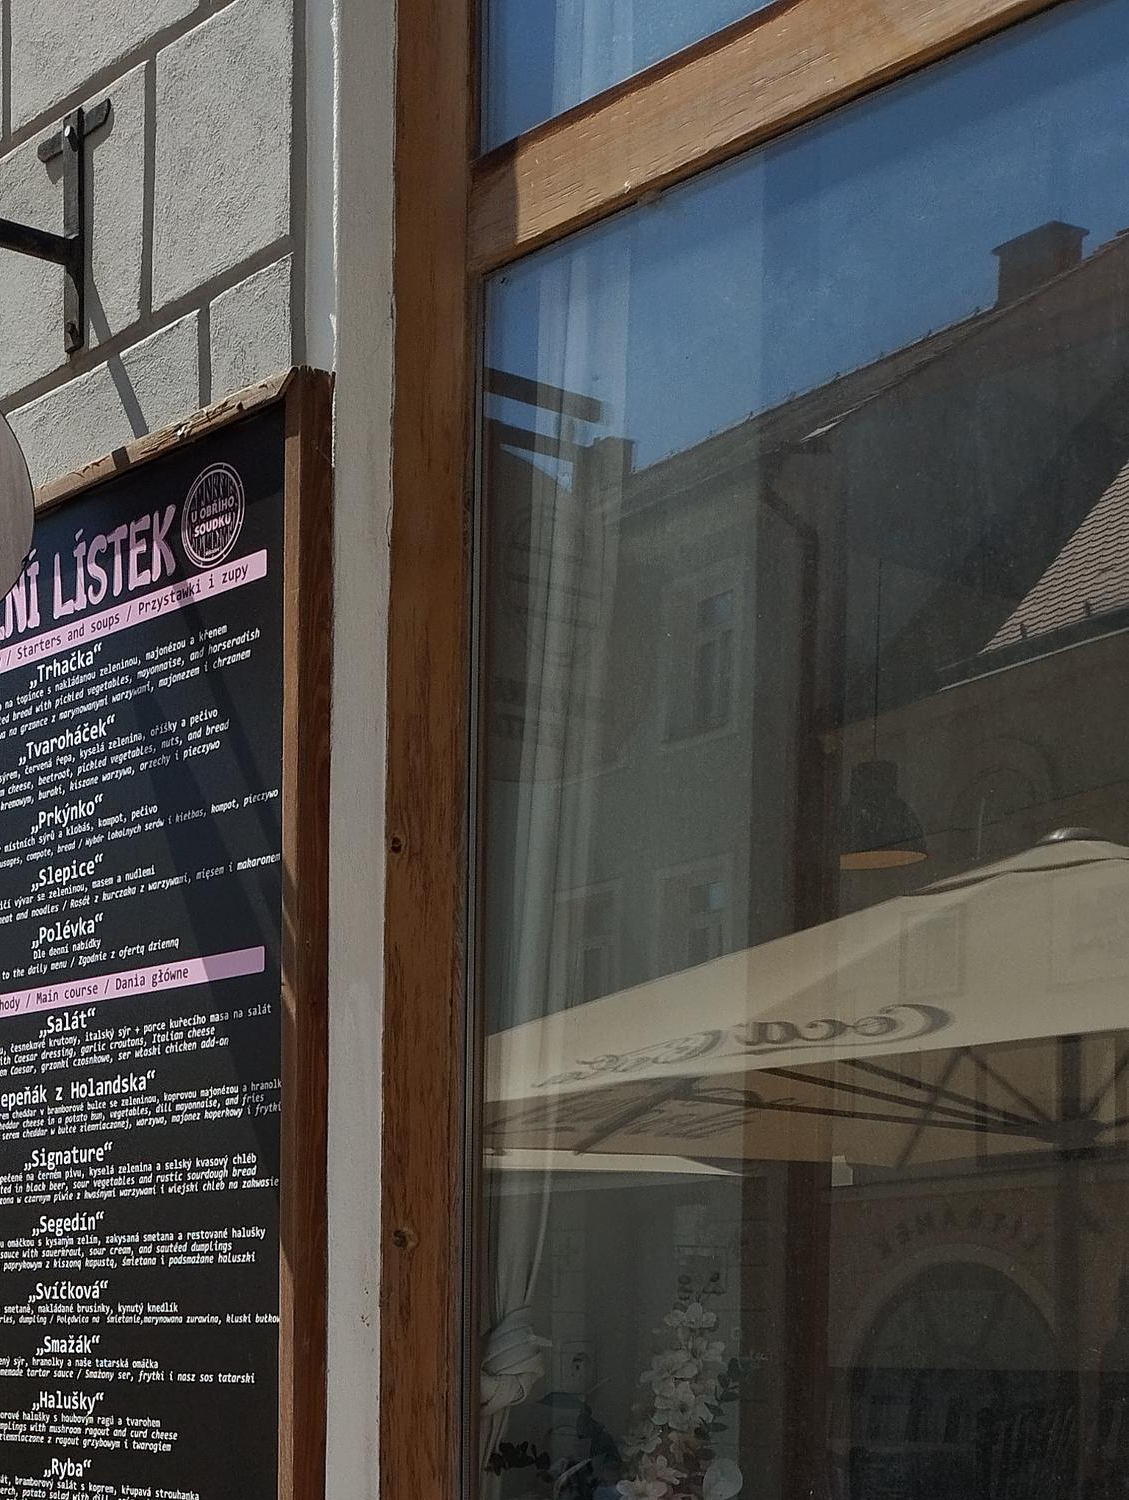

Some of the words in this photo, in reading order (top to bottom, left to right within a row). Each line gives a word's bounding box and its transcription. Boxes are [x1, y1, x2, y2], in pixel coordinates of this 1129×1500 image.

[194, 511, 232, 538] SOUDKU
[52, 504, 177, 620] LÍSTEK
[16, 635, 60, 660] Starters
[66, 624, 83, 642] and
[90, 613, 119, 633] soups
[138, 580, 201, 616] Przystawki
[221, 565, 248, 585] zupy
[36, 990, 58, 1004] Main
[63, 984, 97, 1000] course
[115, 974, 145, 991] Dania
[151, 968, 189, 988] główne
